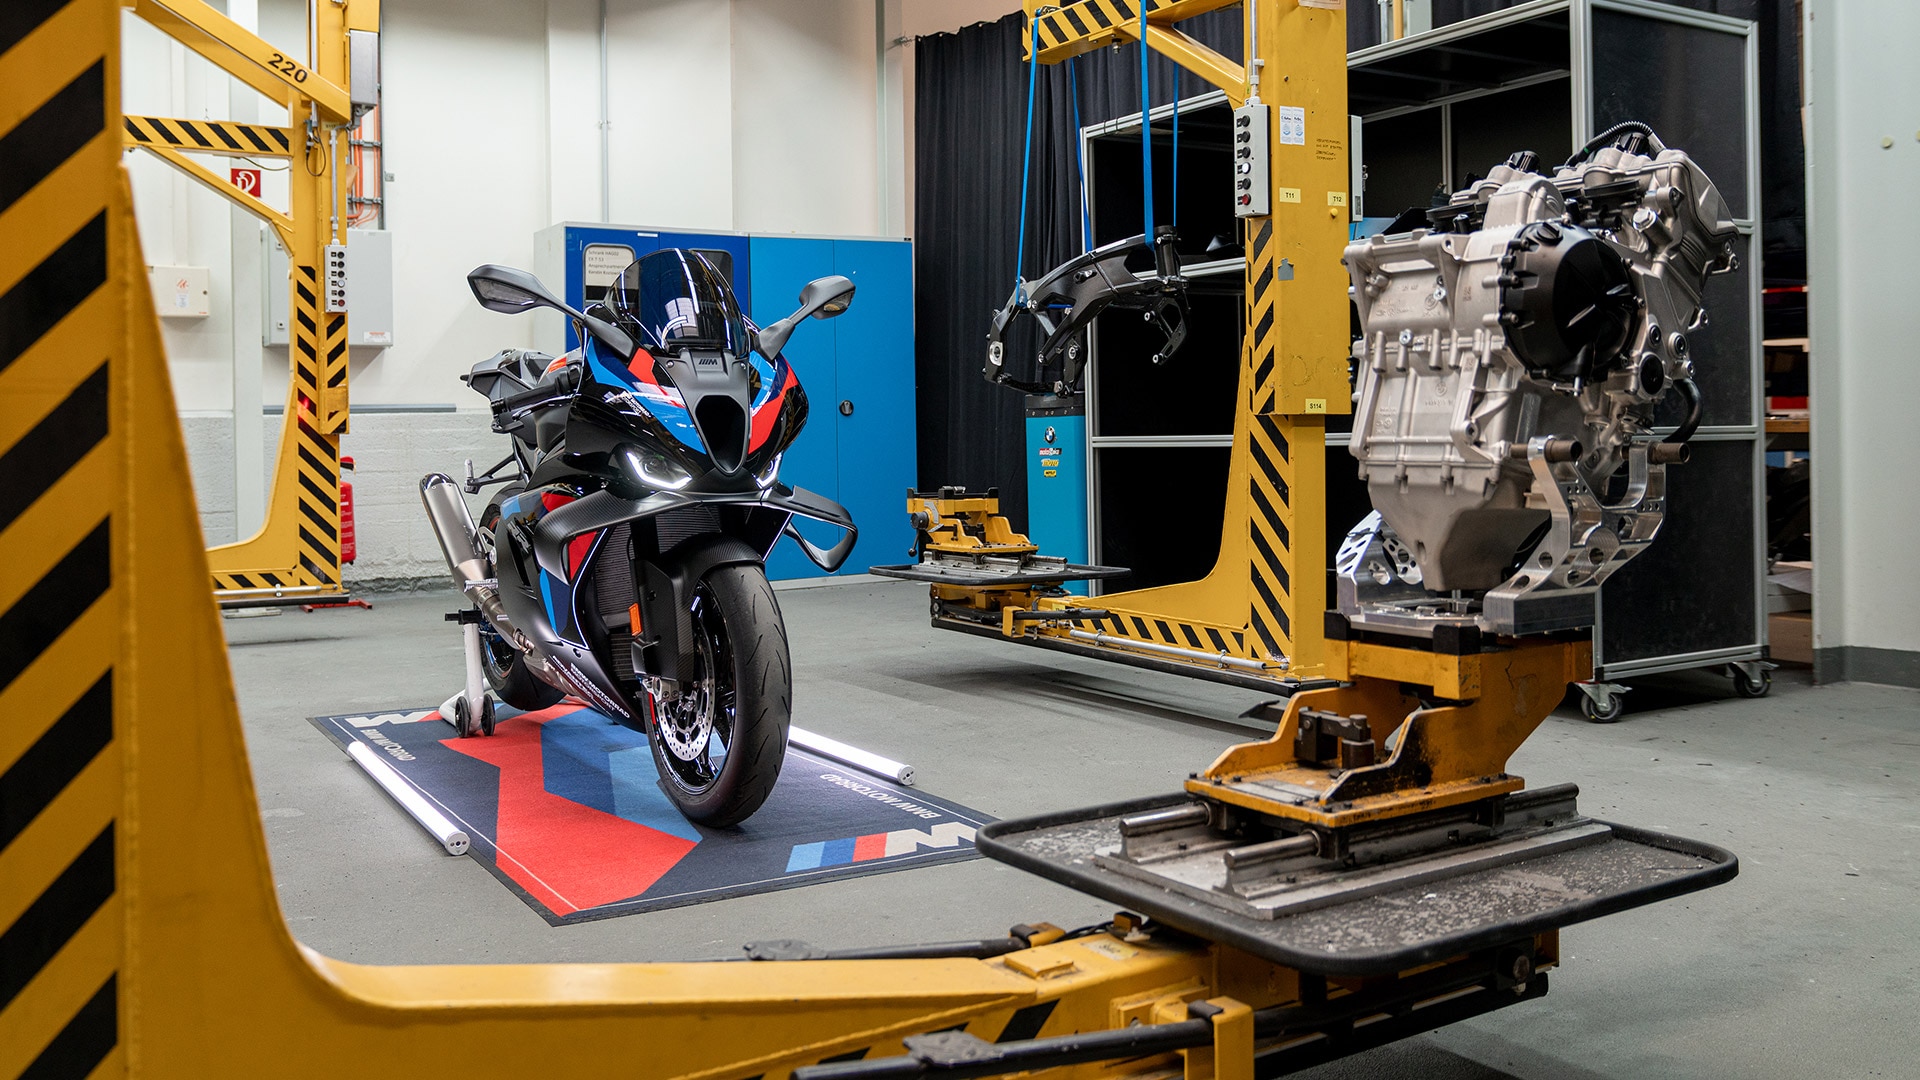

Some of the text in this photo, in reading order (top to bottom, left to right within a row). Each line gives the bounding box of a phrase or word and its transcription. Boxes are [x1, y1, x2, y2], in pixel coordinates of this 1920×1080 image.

[267, 53, 308, 83] 220
[588, 681, 631, 719] MOTORRAD
[819, 773, 943, 819] BMW MOTORRAD
